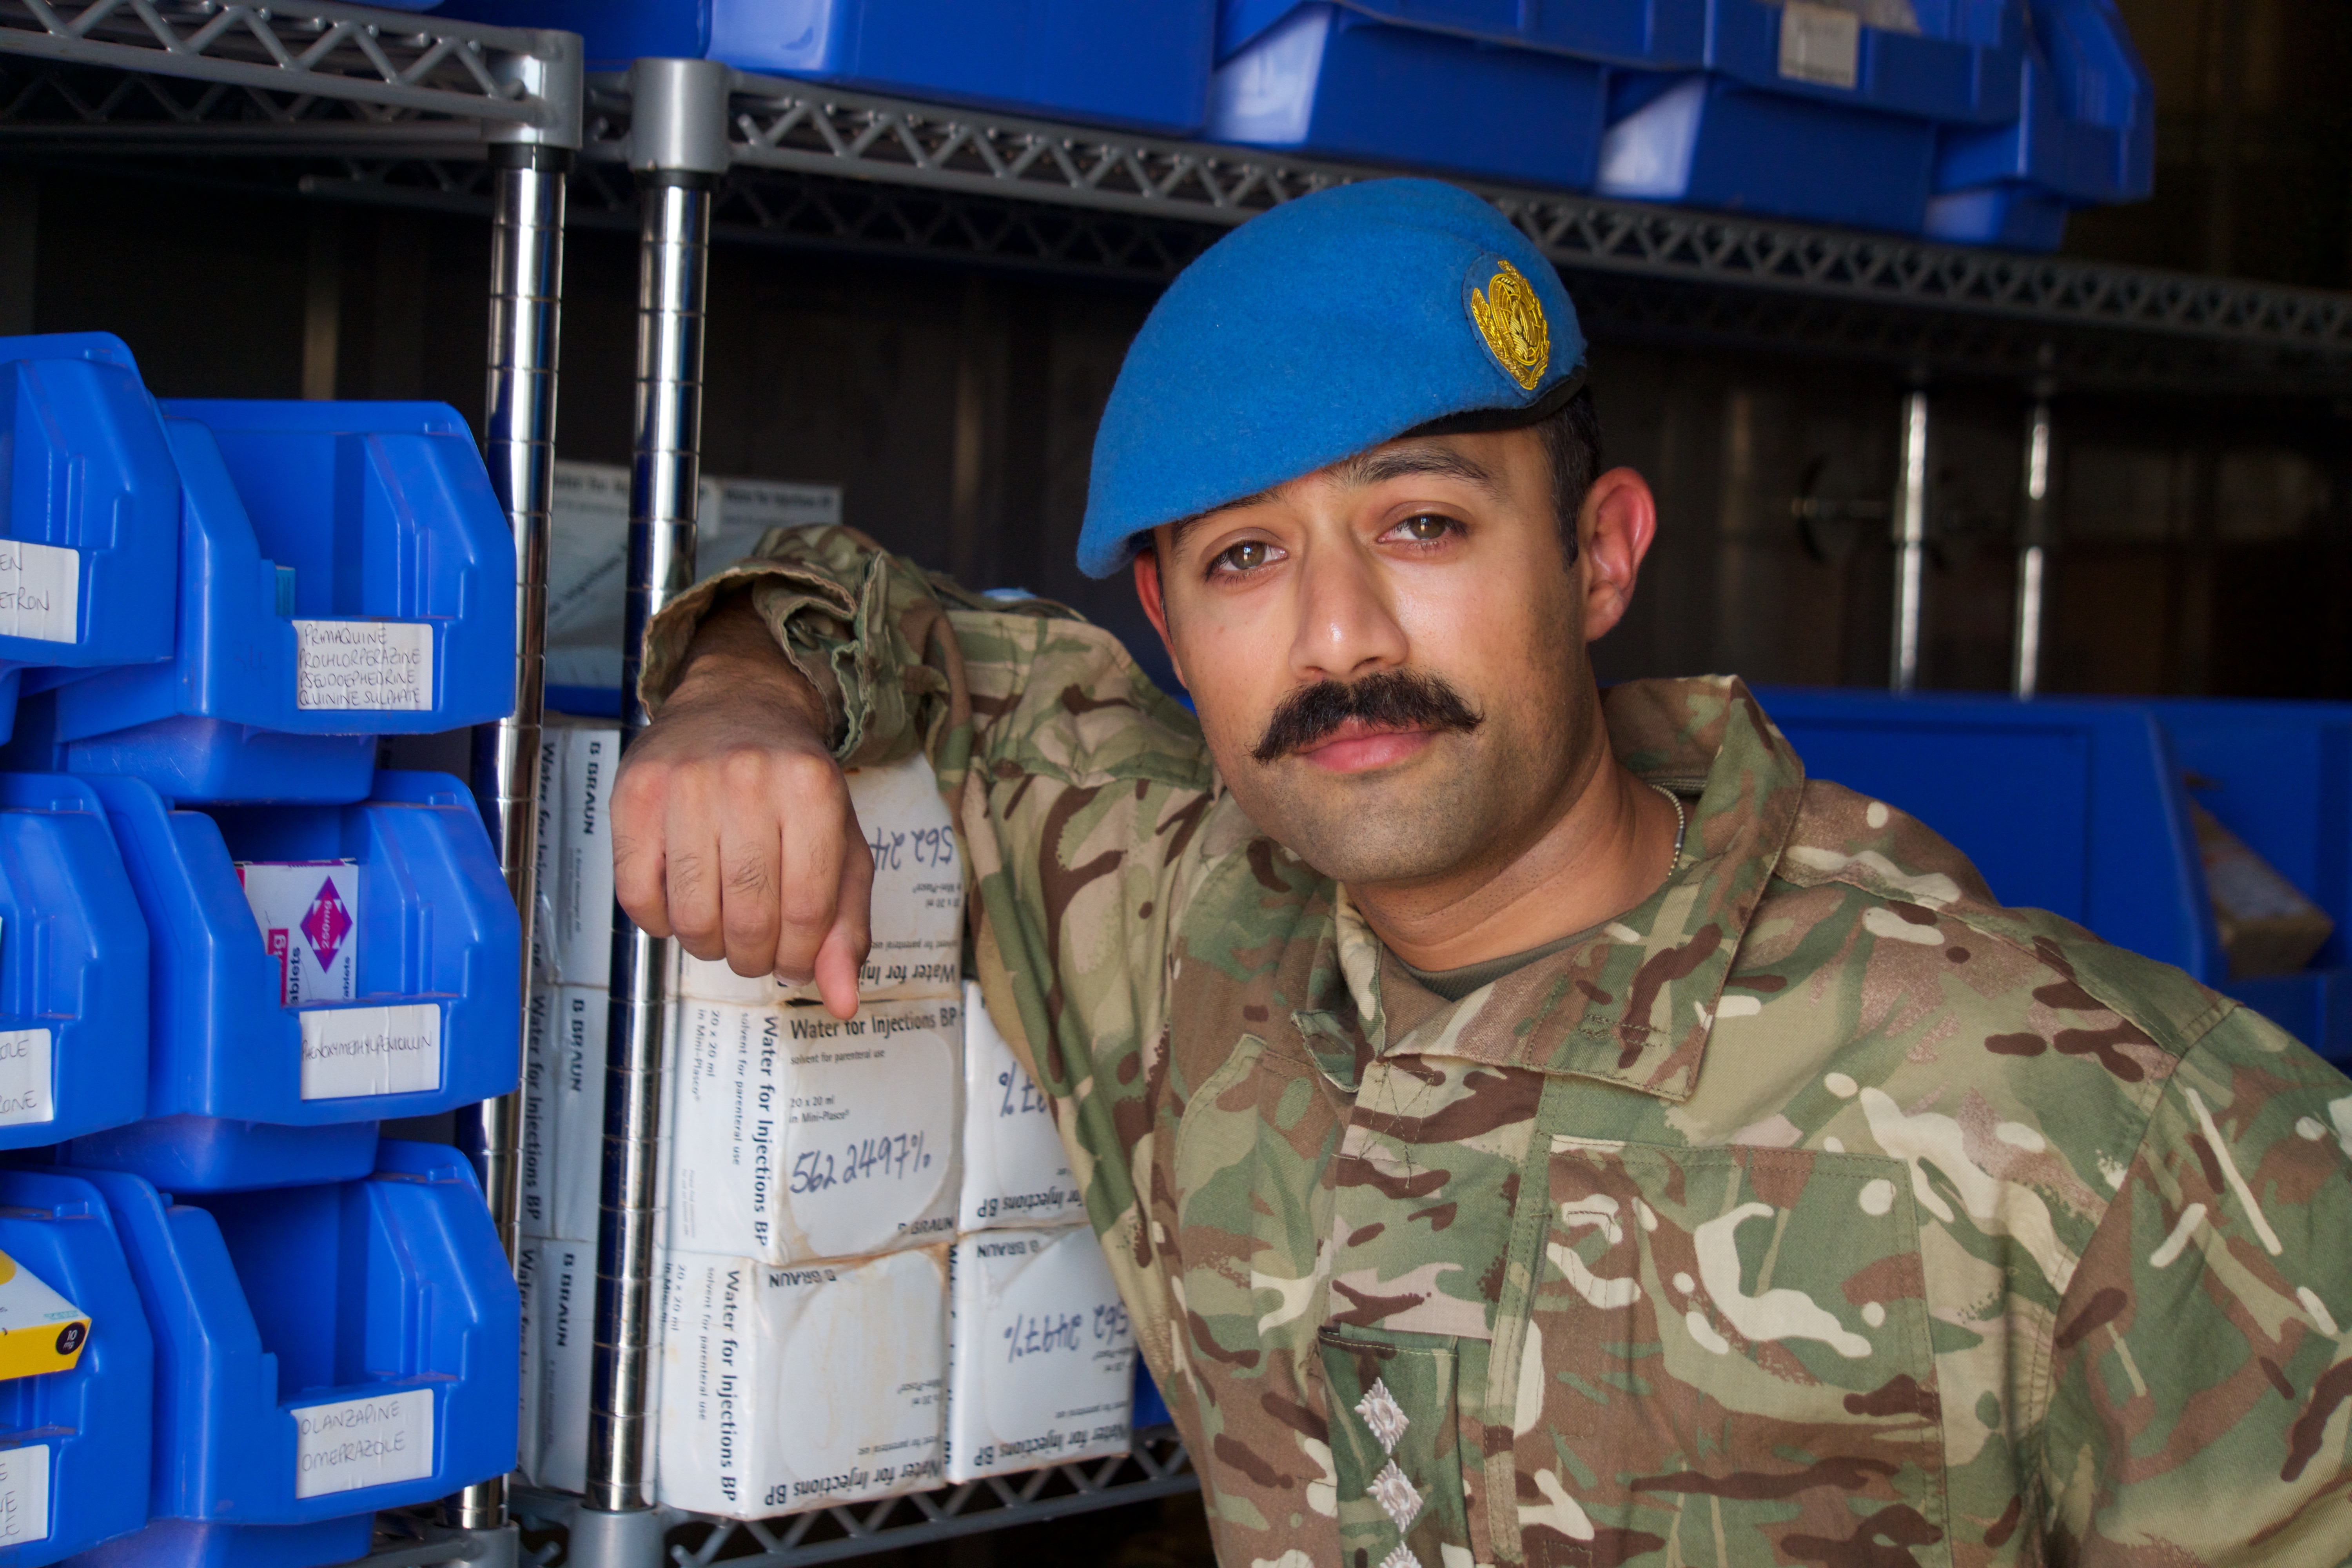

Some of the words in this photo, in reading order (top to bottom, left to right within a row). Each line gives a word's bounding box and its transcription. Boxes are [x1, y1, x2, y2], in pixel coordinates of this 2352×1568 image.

[299, 690, 360, 706] QUININE
[364, 688, 421, 704] SULPHATE
[583, 762, 598, 835] BRAUN
[290, 946, 300, 1004] ablets
[886, 965, 907, 984] for
[912, 964, 955, 982] Water
[573, 998, 584, 1012] B
[698, 1009, 706, 1019] in
[530, 995, 545, 1054] Water
[710, 1010, 720, 1025] 20
[791, 1019, 838, 1040] Water
[845, 1018, 864, 1034] for
[872, 1013, 935, 1039] Injections
[940, 1008, 957, 1027] BP
[739, 1013, 749, 1054] solvent
[571, 1020, 584, 1092] BRAUN
[708, 1042, 717, 1057] 20
[760, 1016, 778, 1076] Water
[791, 1054, 818, 1065] solvent
[821, 1053, 832, 1062] for
[835, 1050, 870, 1061] parenteral
[528, 1061, 544, 1089] for
[706, 1063, 715, 1076] ml
[737, 1060, 747, 1076] for
[0, 1090, 37, 1113] ONE
[758, 1085, 775, 1112] for
[790, 1098, 801, 1107] 20
[813, 1096, 822, 1106] 20
[825, 1094, 834, 1105] ml
[733, 1081, 744, 1141] parenteral
[789, 1113, 798, 1123] in
[526, 1096, 543, 1187] Injections
[732, 1146, 740, 1165] use
[752, 1120, 773, 1214] Injections
[527, 1196, 541, 1220] BP
[977, 1198, 998, 1218] BP
[1003, 1187, 1063, 1213] Injections
[755, 1221, 768, 1246] BP
[977, 1242, 1025, 1257] BRAUN
[677, 1265, 687, 1280] 20
[769, 1271, 822, 1287] BRAUN
[704, 1267, 715, 1308] solvent
[557, 1274, 572, 1347] BRAUN
[673, 1296, 683, 1312] 20
[723, 1270, 740, 1331] Water
[671, 1317, 681, 1331] ml
[702, 1314, 711, 1330] for
[67, 1329, 78, 1341] 10
[722, 1338, 737, 1367] for
[699, 1336, 709, 1396] parenteral
[301, 1400, 400, 1435] OLANZAPINE
[699, 1401, 707, 1420] use
[717, 1375, 737, 1468] Injections
[302, 1430, 406, 1471] OMEPRAZOLE
[974, 1446, 993, 1466] BP
[793, 1466, 869, 1497] Injections
[873, 1467, 895, 1486] for
[721, 1476, 735, 1501] BP
[764, 1484, 786, 1506] BP
